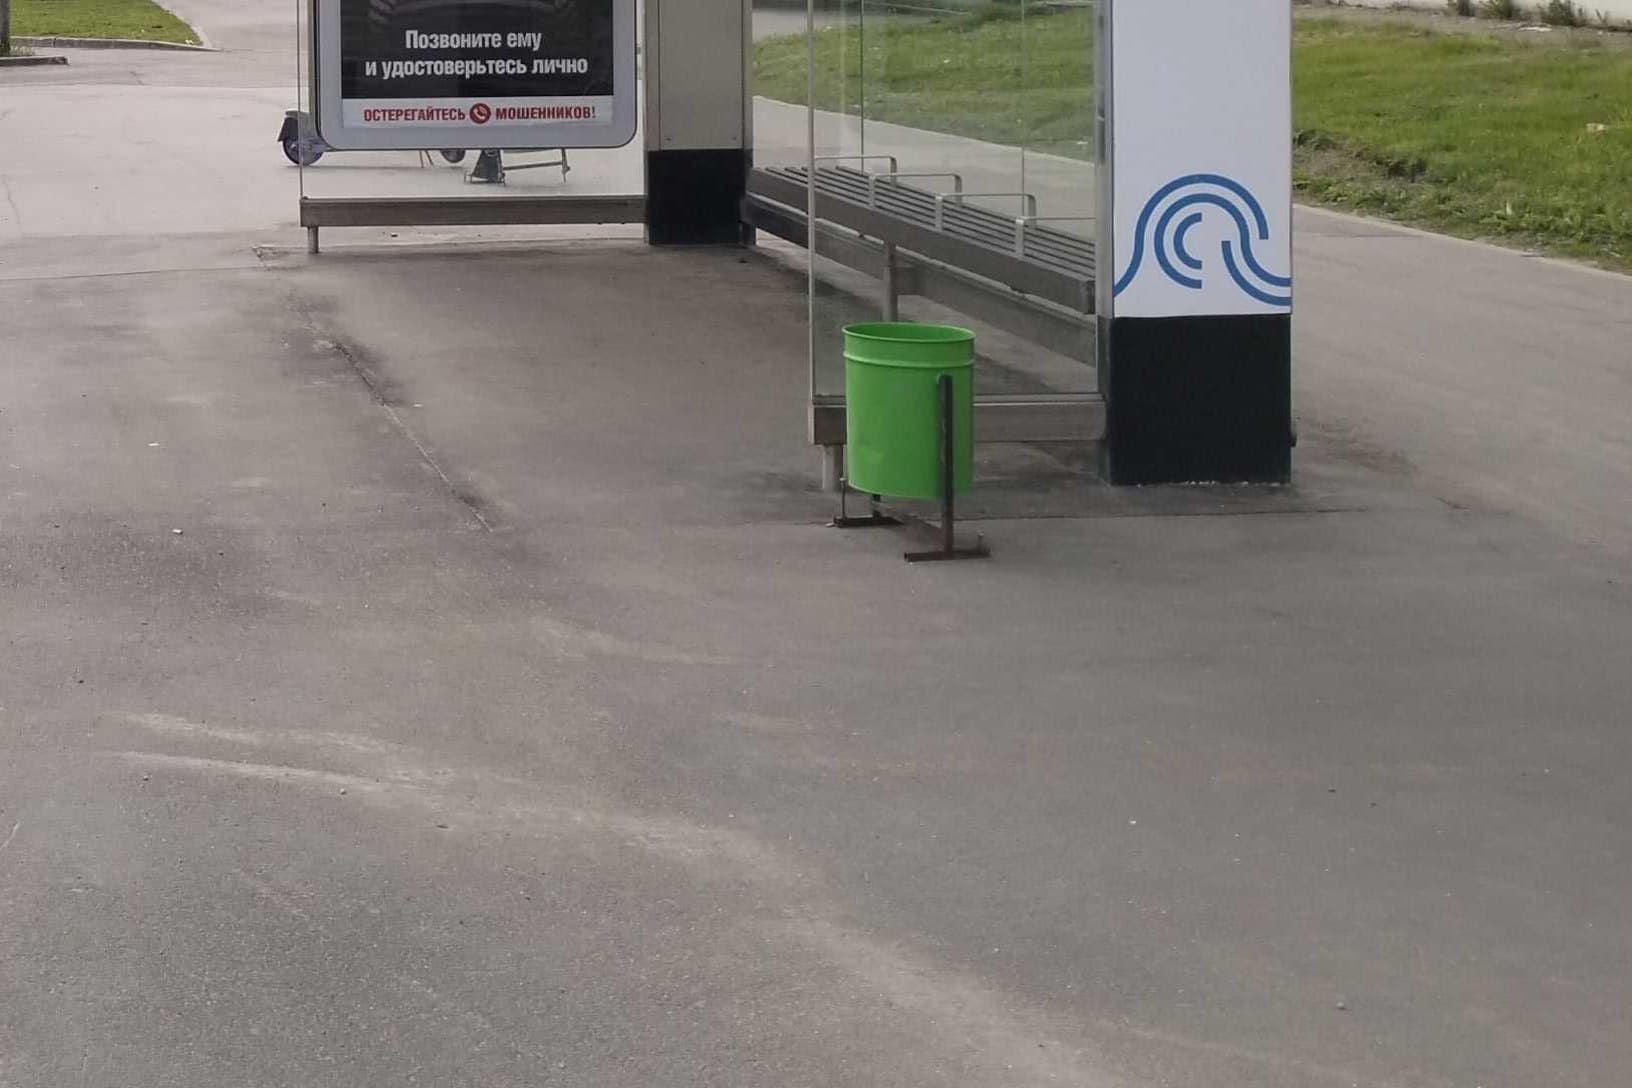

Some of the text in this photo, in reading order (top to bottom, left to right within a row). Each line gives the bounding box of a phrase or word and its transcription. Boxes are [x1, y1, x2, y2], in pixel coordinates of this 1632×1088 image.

[404, 29, 542, 51] Позвоните ему
[365, 57, 588, 80] и удостоверьтесь лично
[363, 105, 597, 122] ОСТЕРЕГАЙТЕСЬ МОШЕННИКОВ!
